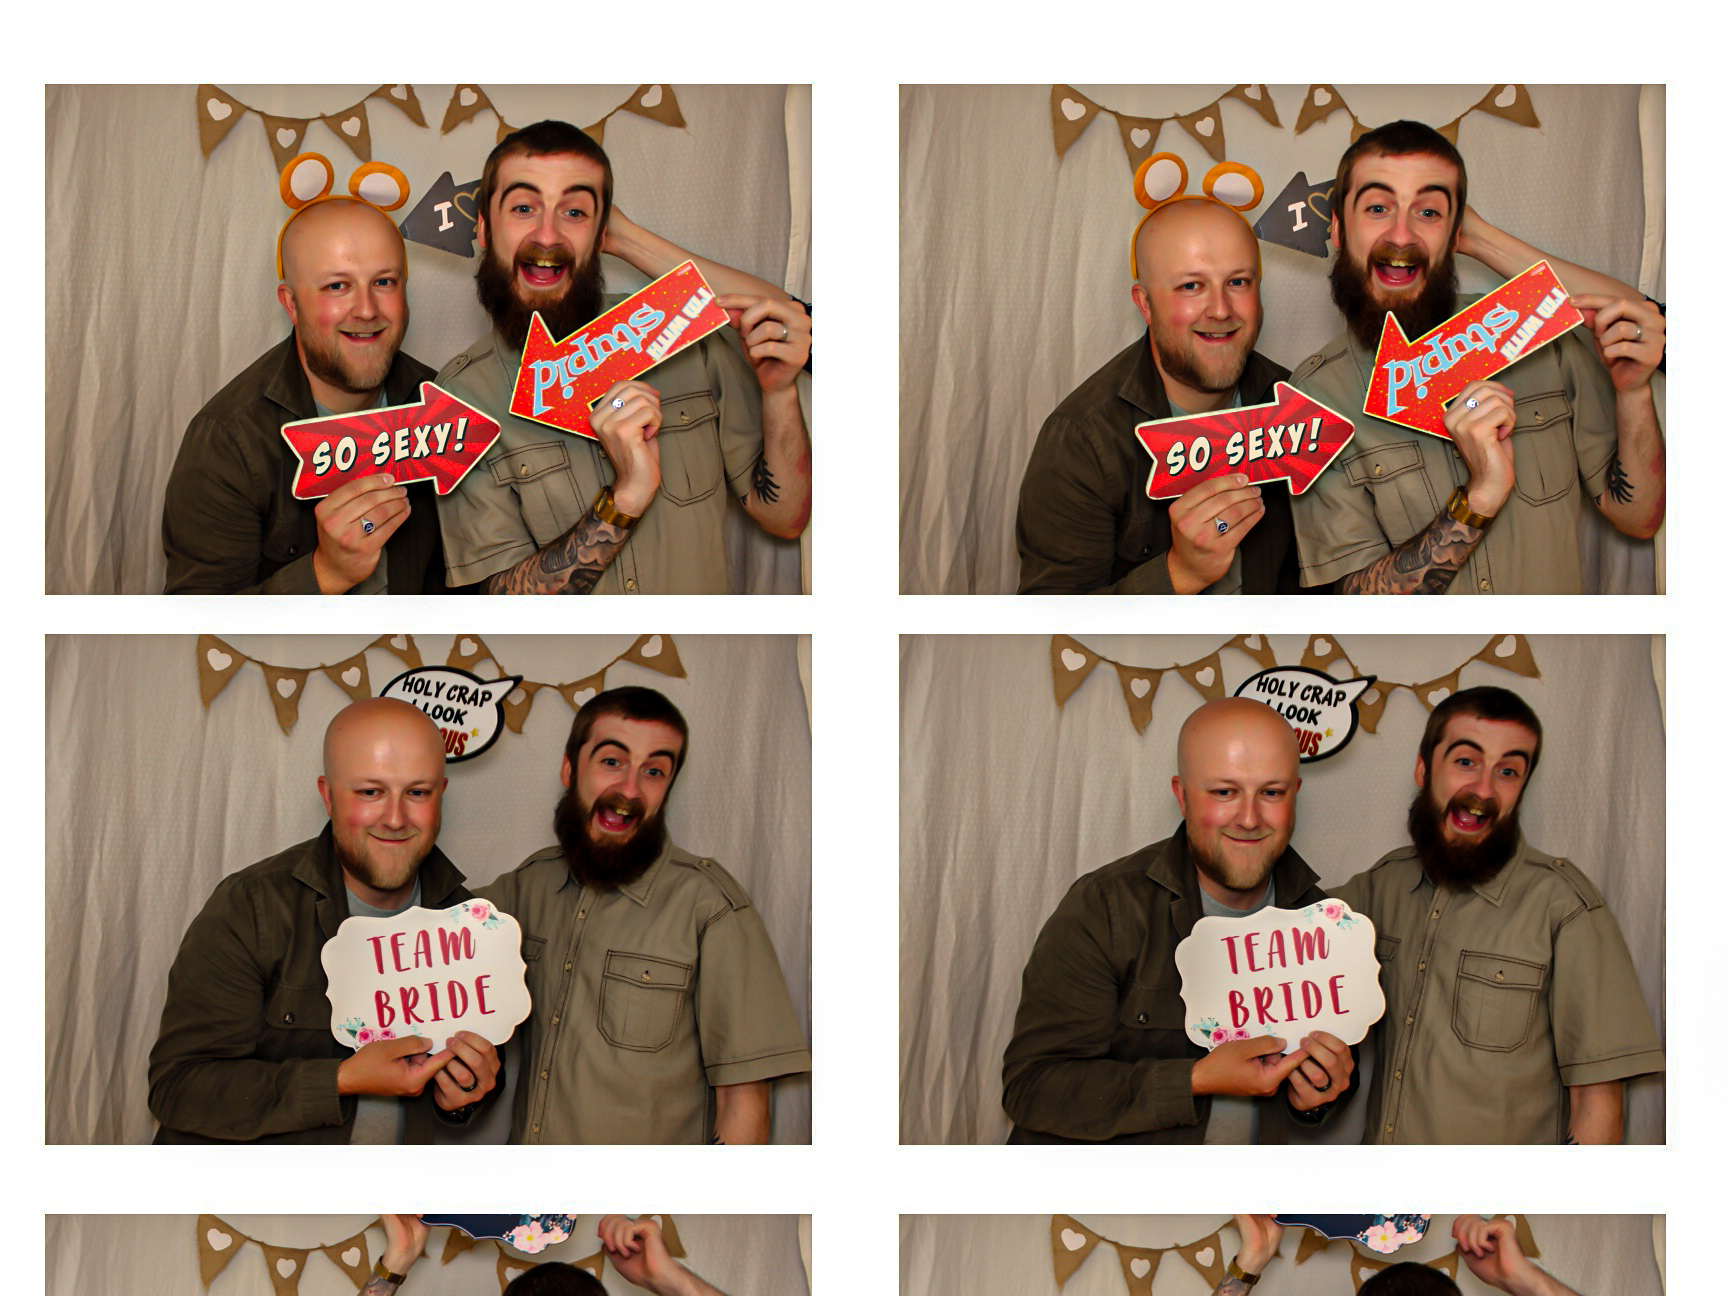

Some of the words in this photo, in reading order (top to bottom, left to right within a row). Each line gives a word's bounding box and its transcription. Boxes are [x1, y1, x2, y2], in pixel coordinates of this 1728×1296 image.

[528, 302, 666, 417] stupid
[645, 314, 691, 362] WITH
[1382, 302, 1520, 417] stupid
[1499, 314, 1545, 362] WITH
[312, 435, 358, 476] SO
[371, 417, 469, 466] SEXY!
[1166, 435, 1212, 476] SO
[1225, 417, 1323, 466] SEXY!
[402, 675, 446, 699] HOLY
[446, 684, 493, 708] CRAP
[1256, 675, 1300, 699] HOLY
[1300, 684, 1347, 708] CRAP
[366, 926, 476, 975] TEAM
[1220, 926, 1330, 975] TEAM
[374, 974, 496, 1029] BRIDE
[1228, 974, 1350, 1029] BRIDE
